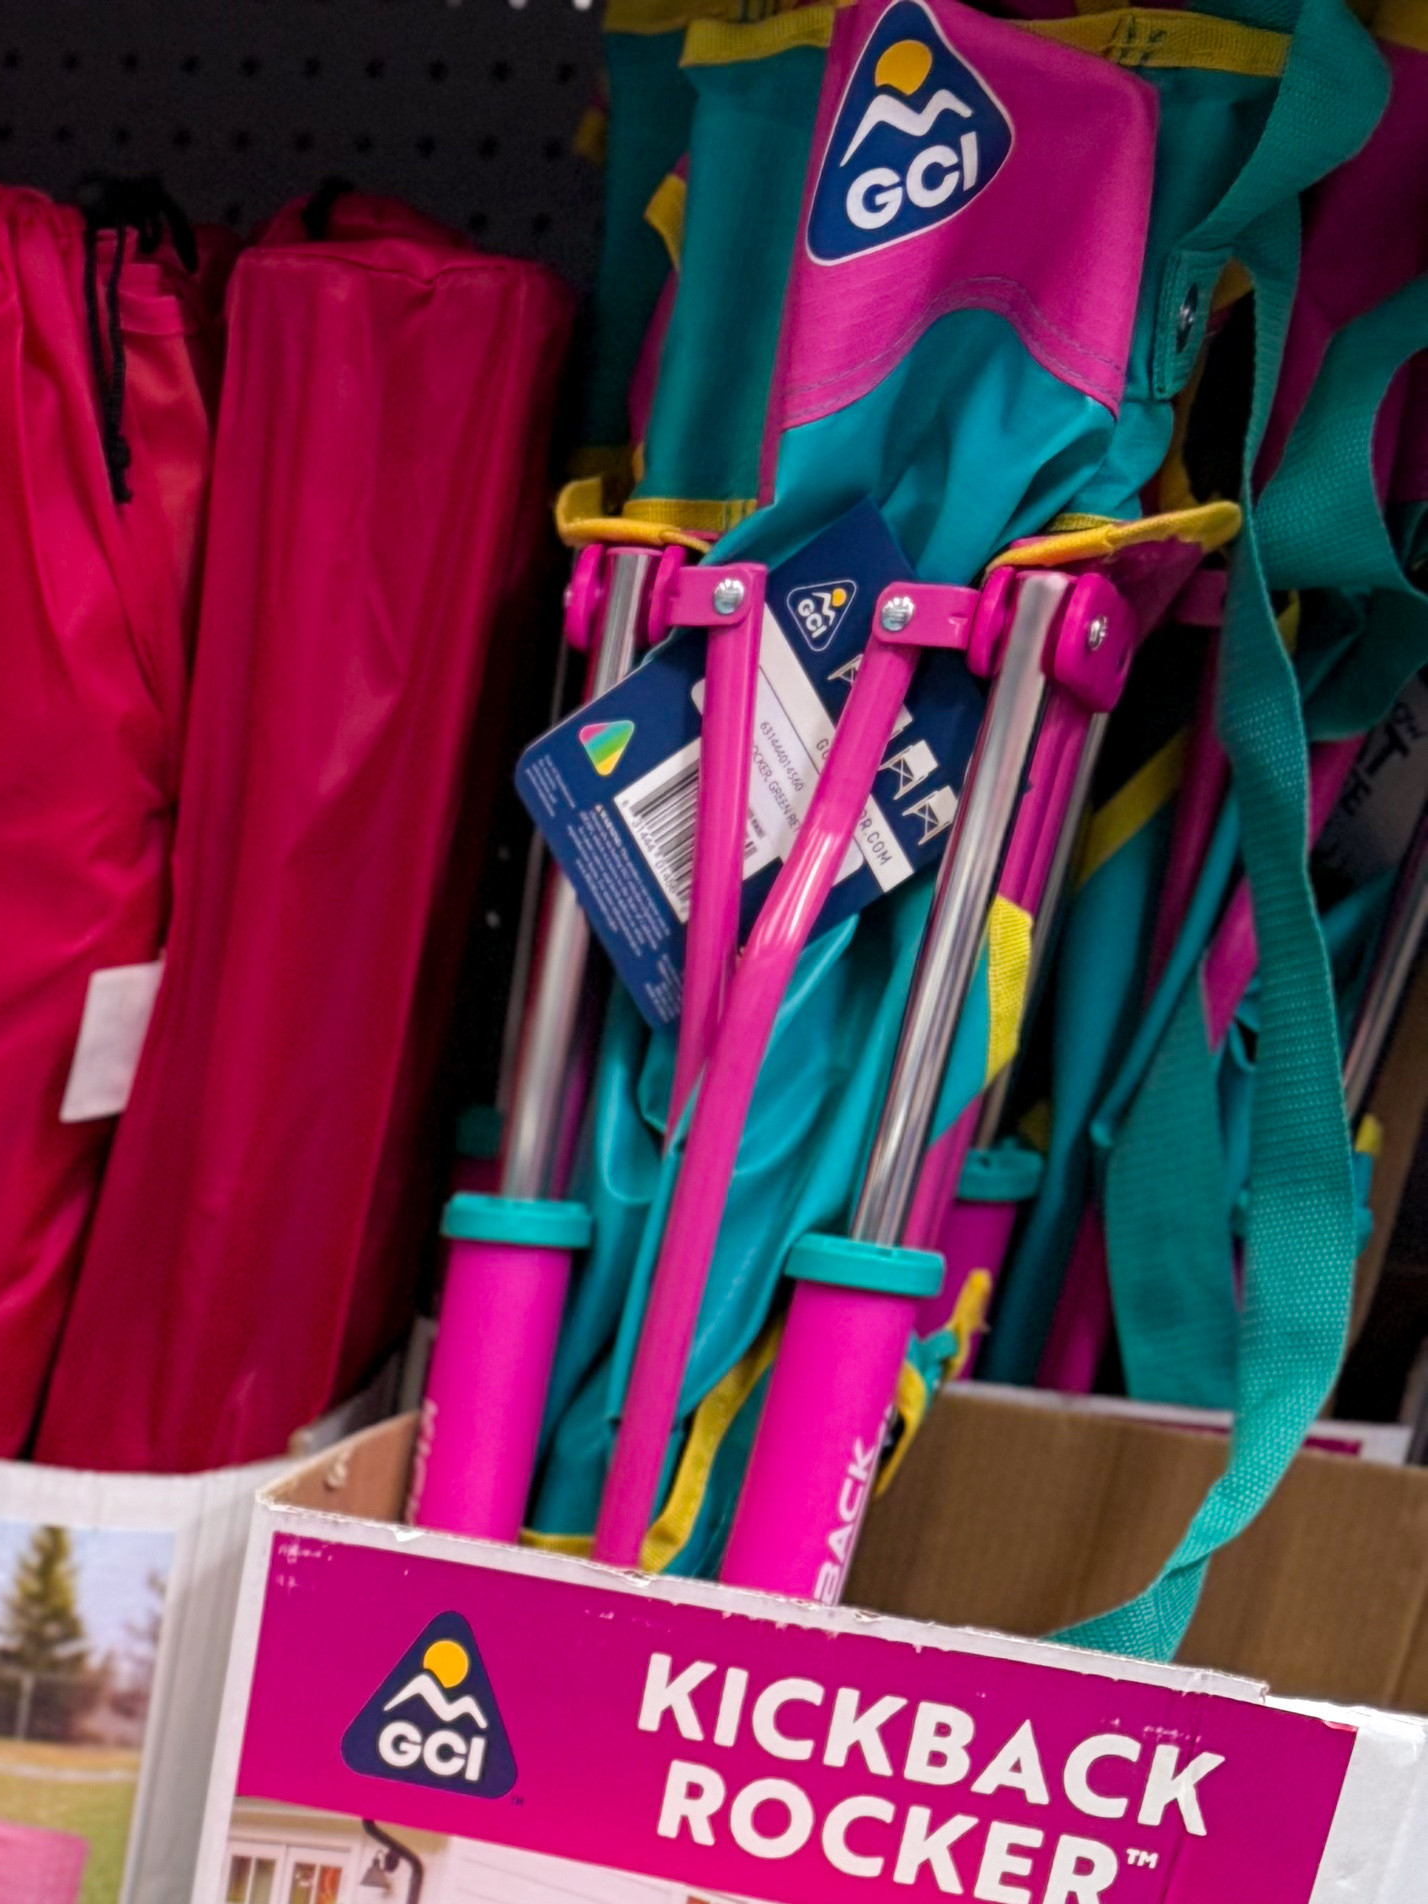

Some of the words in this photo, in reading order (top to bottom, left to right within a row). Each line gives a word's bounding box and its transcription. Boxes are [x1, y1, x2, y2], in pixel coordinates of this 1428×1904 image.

[846, 130, 978, 230] GCI
[797, 598, 828, 639] GCI
[813, 1435, 876, 1607] BACK
[378, 1719, 486, 1782] GCI
[637, 1652, 1226, 1837] KICKBACK
